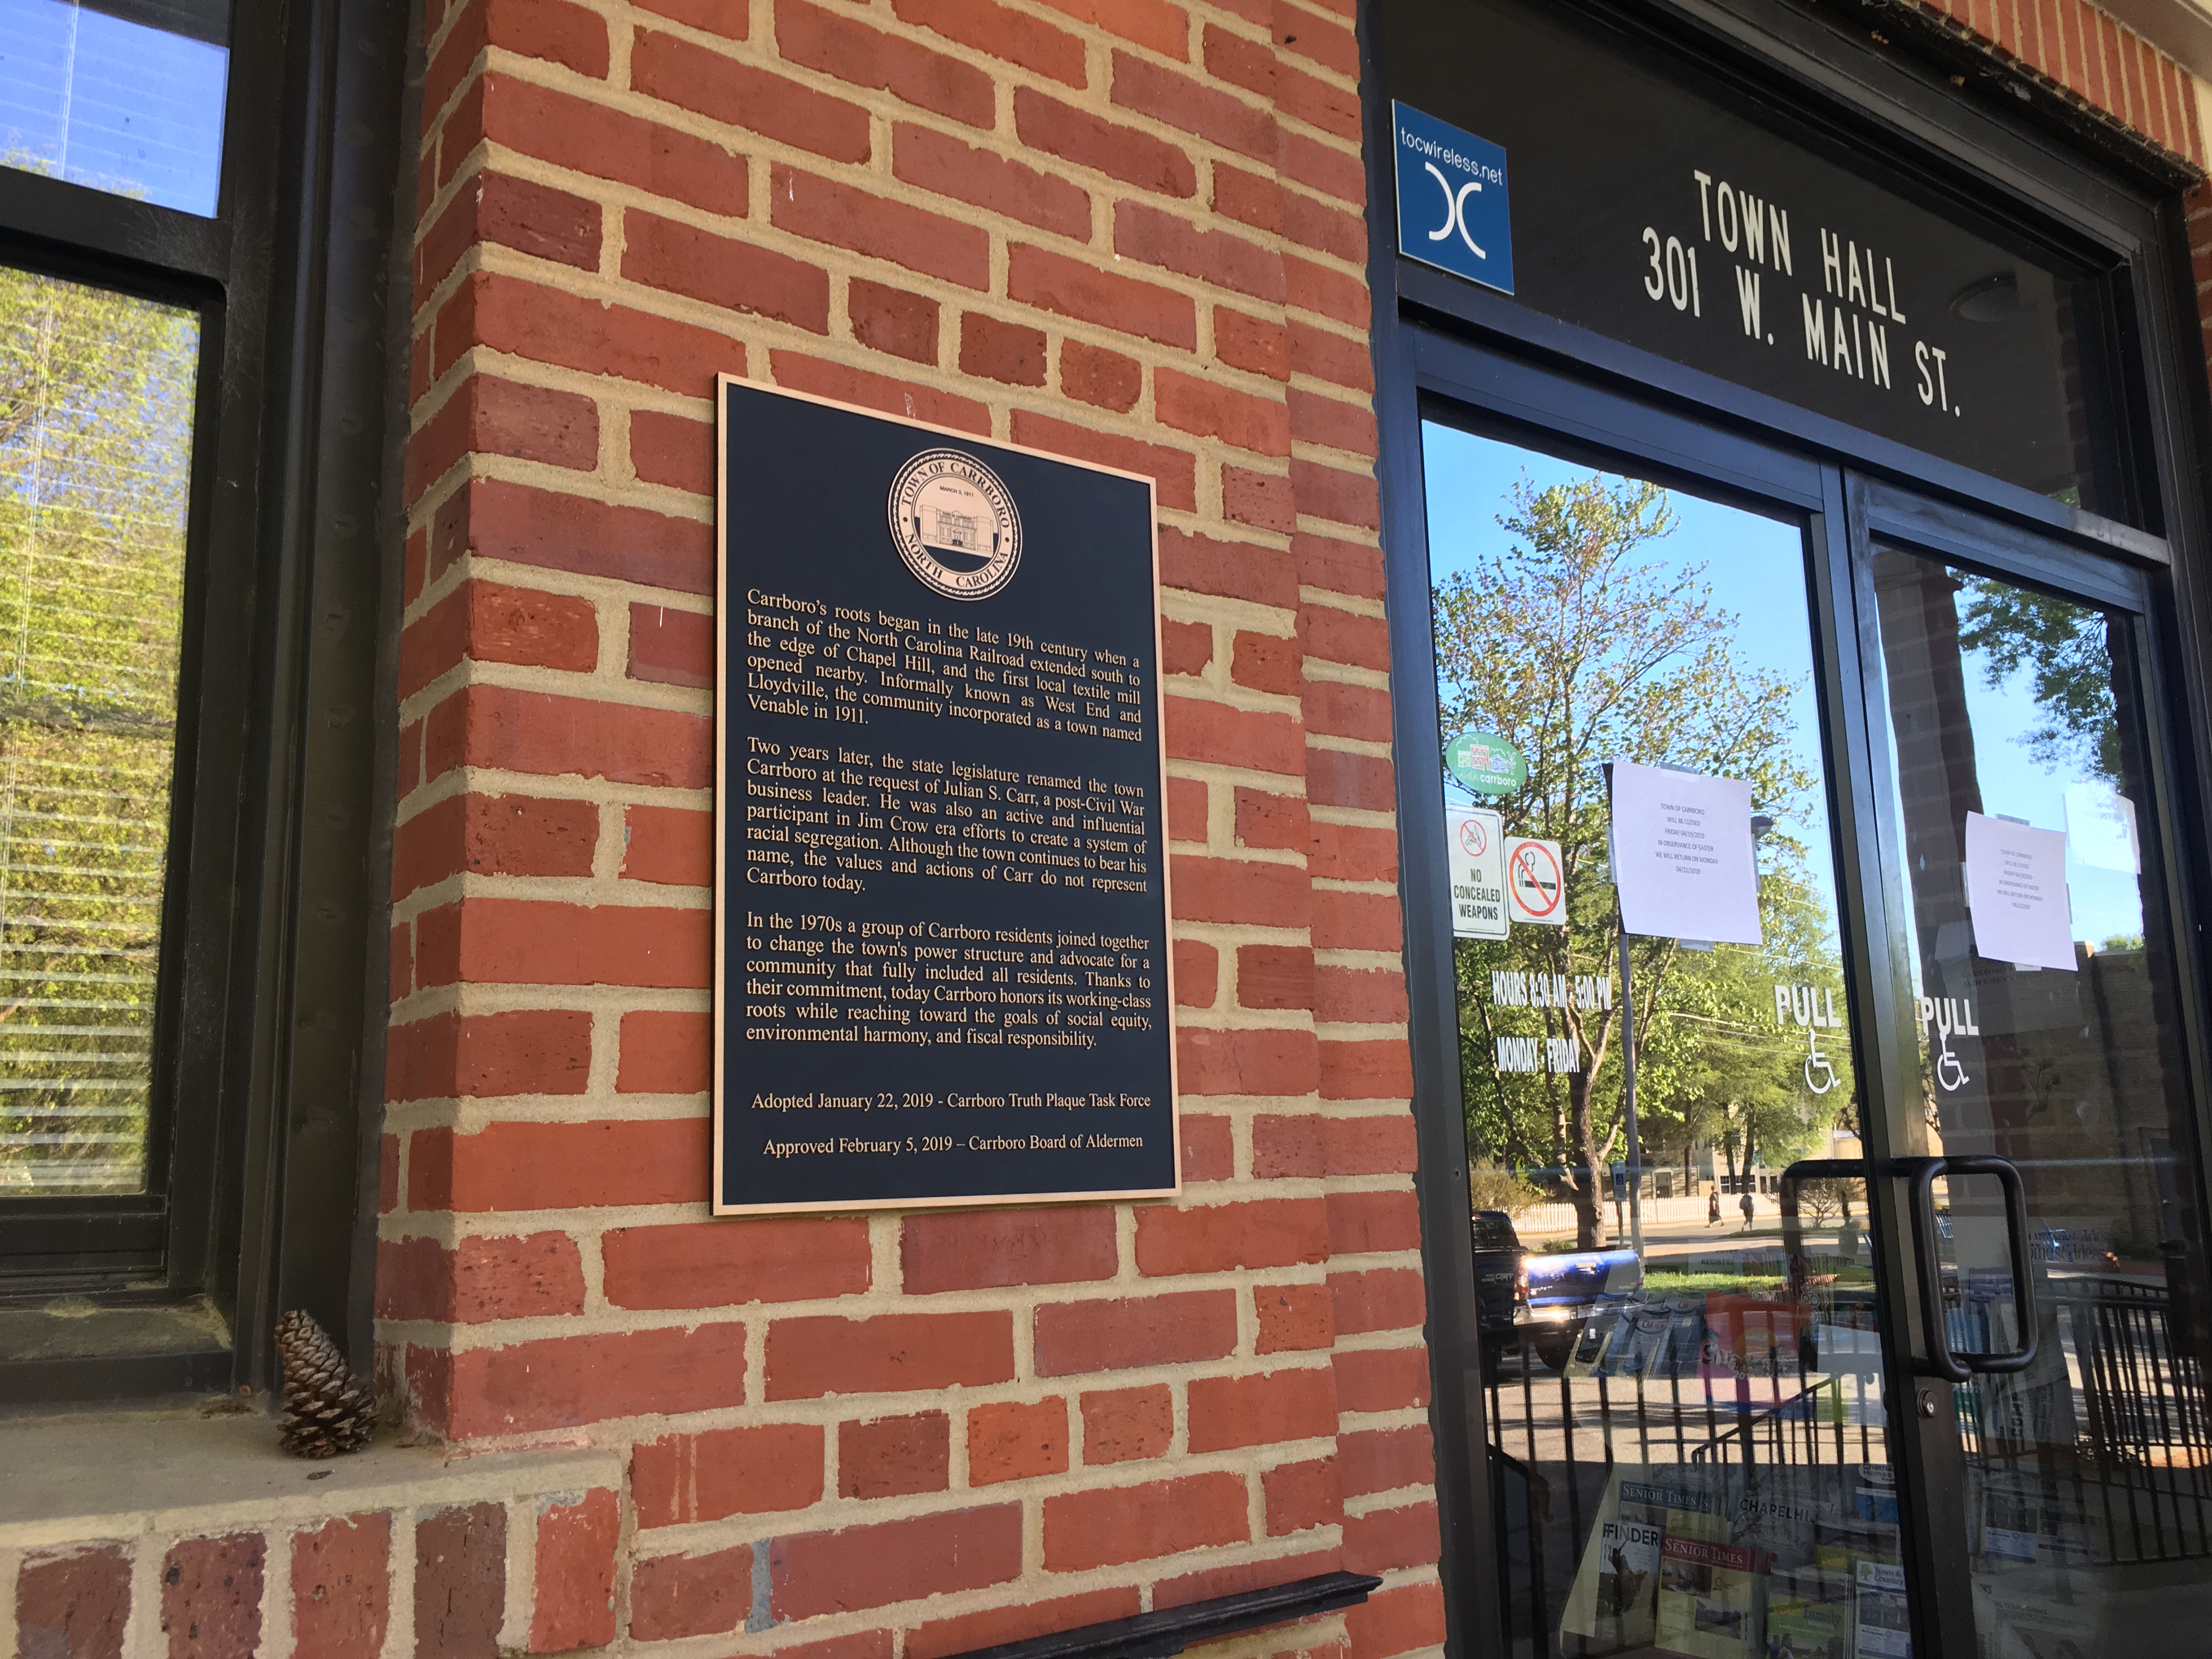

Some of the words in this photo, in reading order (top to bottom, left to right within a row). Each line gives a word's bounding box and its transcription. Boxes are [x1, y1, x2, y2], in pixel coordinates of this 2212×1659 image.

[1401, 127, 1502, 185] tocwireless.net
[1694, 169, 1792, 276] TOWN
[1821, 228, 1906, 324] HALL
[1643, 227, 1700, 318] 301
[1735, 264, 1774, 346] W.
[1802, 292, 1891, 390] MAIN
[1915, 340, 1961, 417] ST.
[901, 468, 928, 506] TOWN
[929, 461, 945, 473] OF
[950, 462, 1009, 528] CARRBORO
[939, 486, 957, 494] MARCH
[905, 533, 944, 579] NORTH
[956, 552, 1008, 588] CAROLINA
[747, 608, 798, 631] branch
[806, 620, 823, 635] of
[828, 622, 850, 639] the
[857, 627, 898, 647] North
[905, 635, 962, 657] Carolina
[969, 645, 1024, 667] Railroad
[1030, 659, 1085, 677] extended
[1091, 669, 1122, 683] south
[1128, 673, 1139, 686] to
[835, 607, 870, 622] roots
[878, 610, 919, 631] began
[928, 618, 940, 634] in
[949, 623, 968, 639] the
[977, 627, 998, 644] late
[1008, 633, 1033, 650] 19th
[1040, 642, 1087, 662] century
[1094, 649, 1126, 665] when
[1133, 658, 1139, 668] a
[747, 630, 771, 647] the
[780, 636, 815, 657] edge
[823, 643, 840, 658] of
[847, 646, 895, 668] Chapel
[905, 654, 934, 675] Hill,
[943, 663, 967, 678] and
[975, 666, 995, 682] the
[1003, 670, 1029, 687] first
[1036, 675, 1065, 692] local
[1073, 683, 1110, 699] textile
[1117, 690, 1140, 704] mill
[747, 656, 802, 673] opened
[816, 665, 867, 686] nearby.
[881, 671, 953, 698] Informally
[965, 683, 1009, 703] known
[1021, 696, 1034, 707] as
[1045, 695, 1075, 713] West
[1086, 702, 1109, 718] End
[1120, 709, 1141, 723] and
[748, 672, 828, 701] Lloydville,
[834, 685, 856, 701] the
[862, 693, 943, 716] community
[949, 700, 1031, 726] incorporated
[1036, 718, 1049, 729] as
[1054, 720, 1061, 730] a
[1066, 720, 1097, 735] town
[1102, 727, 1141, 741] named
[748, 693, 808, 715] Venable
[814, 702, 827, 718] in
[835, 706, 868, 724] 1911.
[1458, 770, 1477, 780] walk
[1480, 774, 1516, 787] carrboro
[1681, 806, 1705, 815] CARRBORO
[1663, 840, 1691, 849] OBSERVANCE
[1680, 830, 1705, 838] 04/19/2019
[1470, 868, 1481, 883] NO
[1676, 866, 1700, 874] 04/22/2019
[1454, 885, 1500, 902] CONCEALED
[1459, 904, 1498, 921] WEAPONS
[1492, 970, 1527, 1006] HOURS
[1529, 972, 1550, 1007] 8:30
[1553, 974, 1567, 1008] AM
[1575, 975, 1595, 1009] 5:00
[1596, 977, 1612, 1010] PM
[1774, 985, 1842, 1028] PULL
[1921, 996, 1979, 1036] PULL
[746, 1023, 857, 1041] environmental
[864, 1025, 931, 1046] harmony,
[936, 1028, 961, 1043] and
[967, 1028, 1002, 1043] fiscal
[1007, 1030, 1096, 1049] responsibility.
[1497, 1036, 1537, 1071] MONDAY
[1546, 1038, 1580, 1073] FRIDAY
[751, 1092, 812, 1111] Adopted
[817, 1093, 872, 1111] January
[877, 1093, 898, 1110] 22,
[902, 1093, 933, 1107] 2019
[947, 1093, 1005, 1107] Carrboro
[1008, 1092, 1041, 1107] Truth
[1046, 1092, 1085, 1110] Plaque
[1088, 1093, 1115, 1106] Task
[1119, 1093, 1150, 1106] Force
[763, 1137, 833, 1158] Approved
[839, 1137, 901, 1155] February
[906, 1137, 917, 1154] 5,
[922, 1136, 952, 1150] 2019
[969, 1135, 1025, 1150] Carrboro
[1030, 1134, 1065, 1148] Board
[1070, 1133, 1083, 1148] of
[1086, 1133, 1142, 1147] Aldermen
[1623, 1483, 1662, 1502] SENIOR
[1666, 1489, 1697, 1506] TIMES
[1665, 1538, 1708, 1558] SENIOR
[1711, 1546, 1743, 1565] TIMES
[1875, 1567, 1894, 1576] Town
